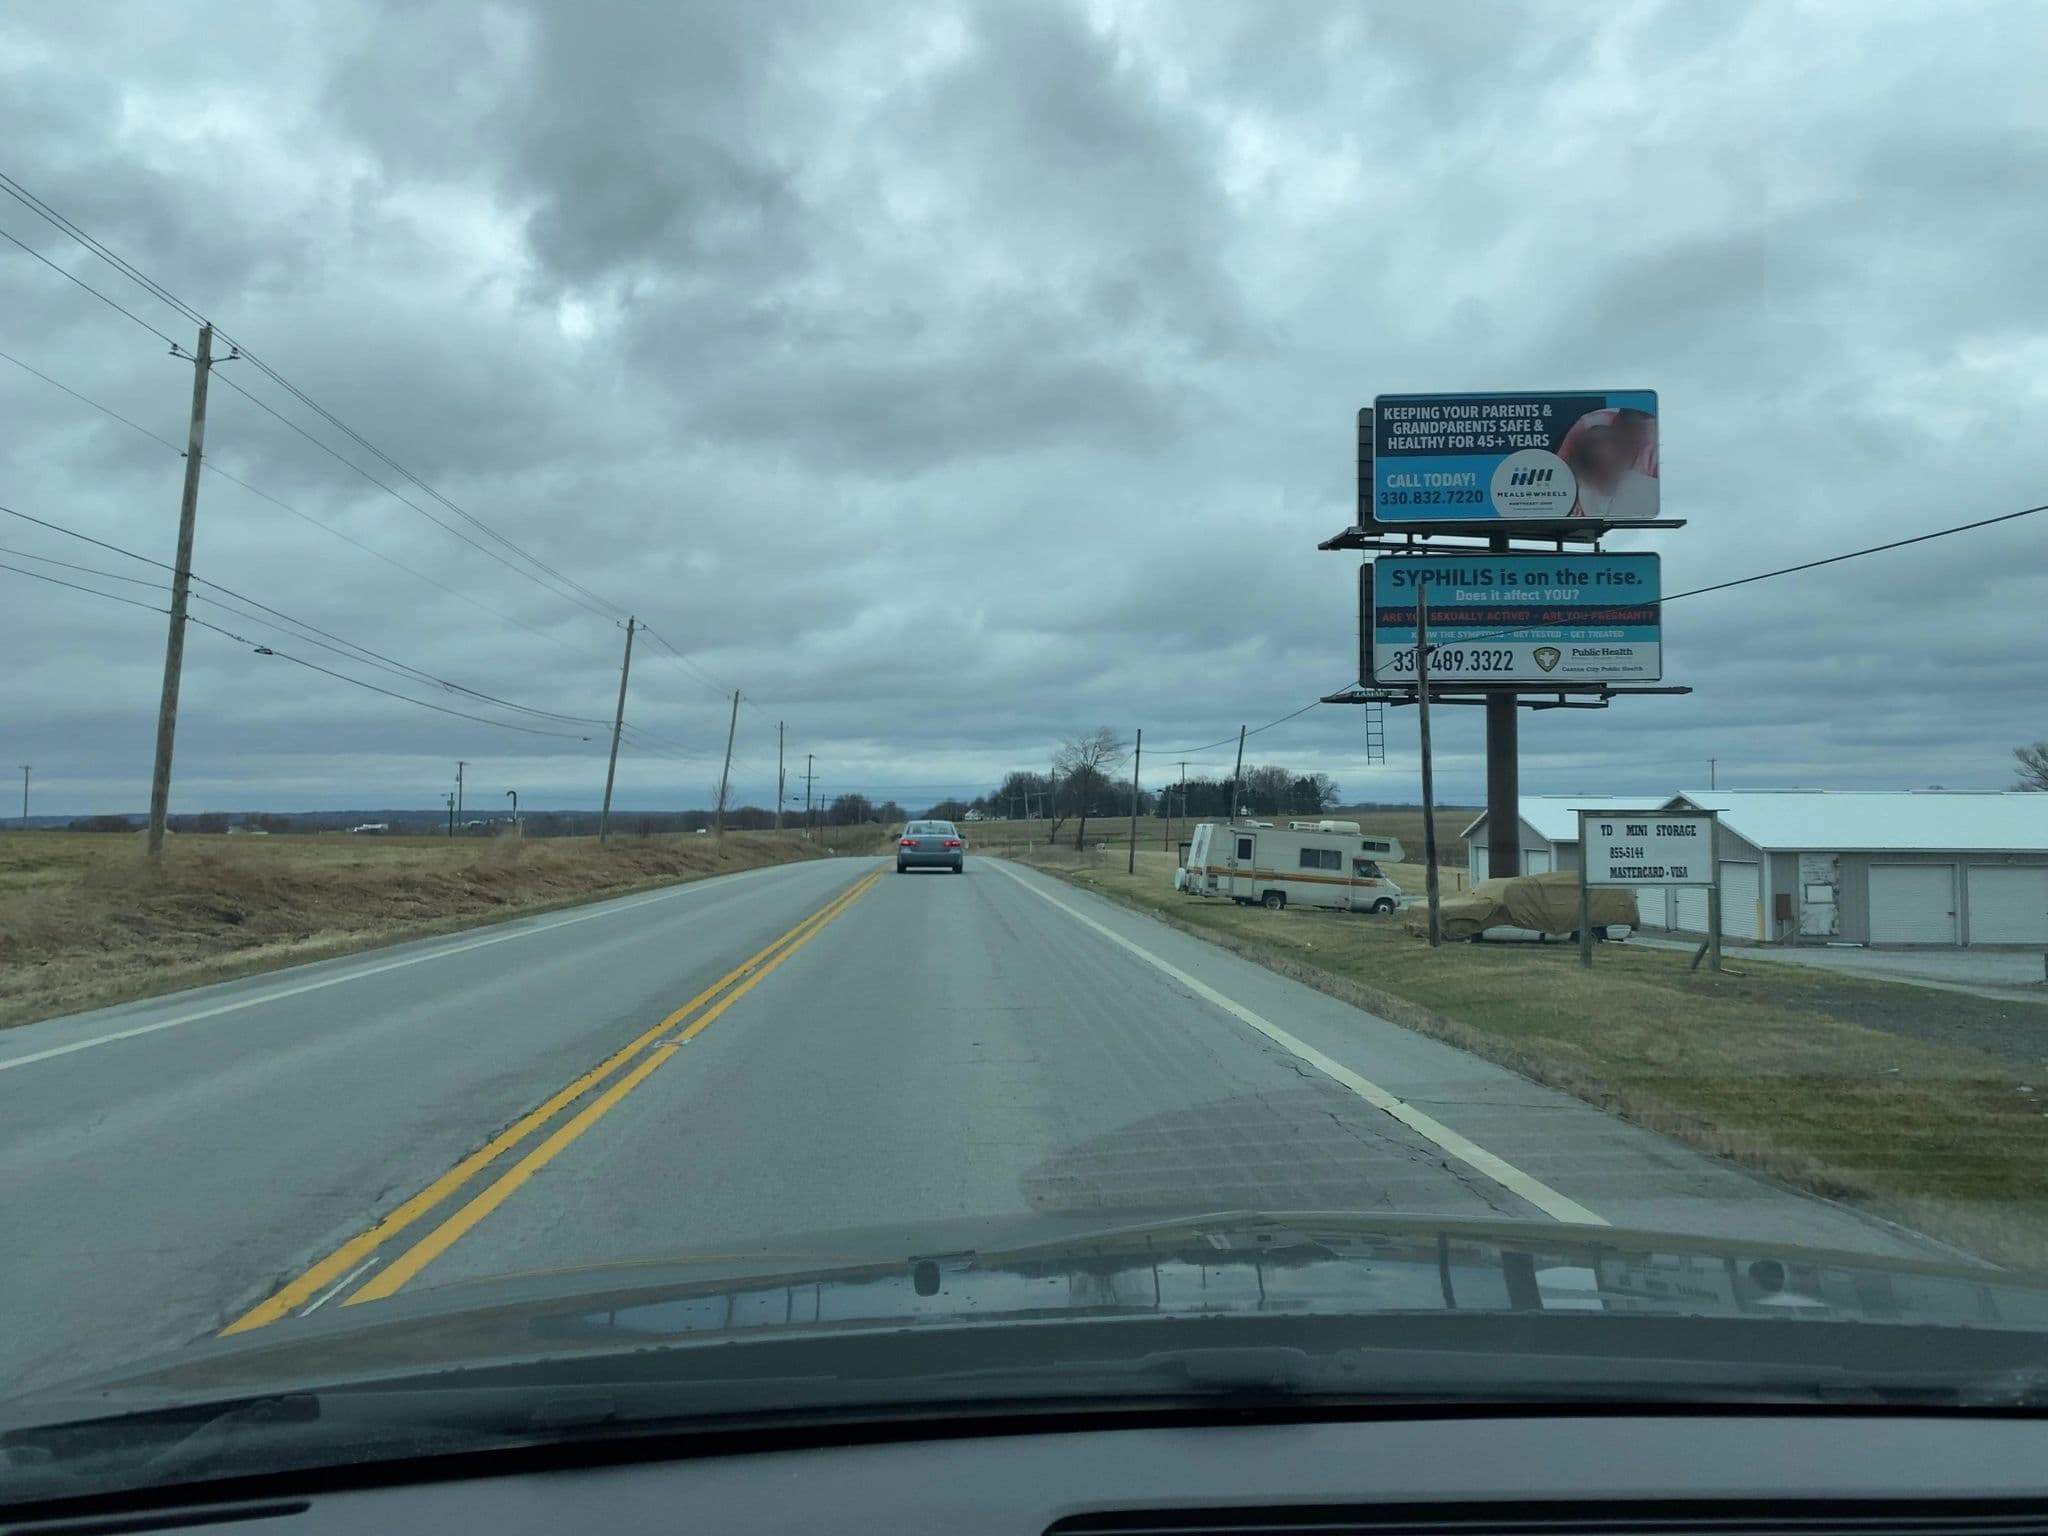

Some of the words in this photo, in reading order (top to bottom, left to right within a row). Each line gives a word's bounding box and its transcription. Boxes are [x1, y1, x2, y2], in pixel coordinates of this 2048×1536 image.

[1384, 407, 1440, 420] KEEPING
[1442, 406, 1479, 419] YOUR
[1482, 404, 1540, 418] PARENTS
[1543, 404, 1553, 416] &
[1393, 420, 1497, 434] GRANDPARENTS
[1499, 419, 1530, 432] SAFE
[1534, 419, 1544, 432] &
[1388, 435, 1446, 450] HEALTHY
[1448, 435, 1475, 449] FOR
[1477, 435, 1505, 448] 45+
[1508, 434, 1550, 447] YEARS
[1387, 474, 1421, 488] CALL
[1423, 472, 1476, 487] TODAY!
[1380, 490, 1484, 506] 330.832.7220
[1392, 569, 1493, 588] SYPHILIS
[1500, 569, 1518, 586] is
[1525, 571, 1549, 586] on
[1556, 568, 1588, 585] the
[1596, 567, 1643, 585] rise.
[1456, 589, 1488, 602] Does
[1491, 589, 1501, 601] it
[1503, 588, 1540, 601] affect
[1543, 588, 1580, 601] YOU?
[1382, 613, 1403, 622] ARE
[1431, 612, 1483, 621] SEXUALLY
[1487, 611, 1530, 620] ACTIVE?
[1531, 630, 1562, 638] TESTED
[1589, 630, 1625, 638] TREATED
[1572, 648, 1601, 656] Public
[1602, 647, 1633, 656] Health
[1393, 650, 1514, 672] 33.489.3322
[1626, 825, 1648, 836] MINI
[1656, 825, 1697, 836] STORAGE
